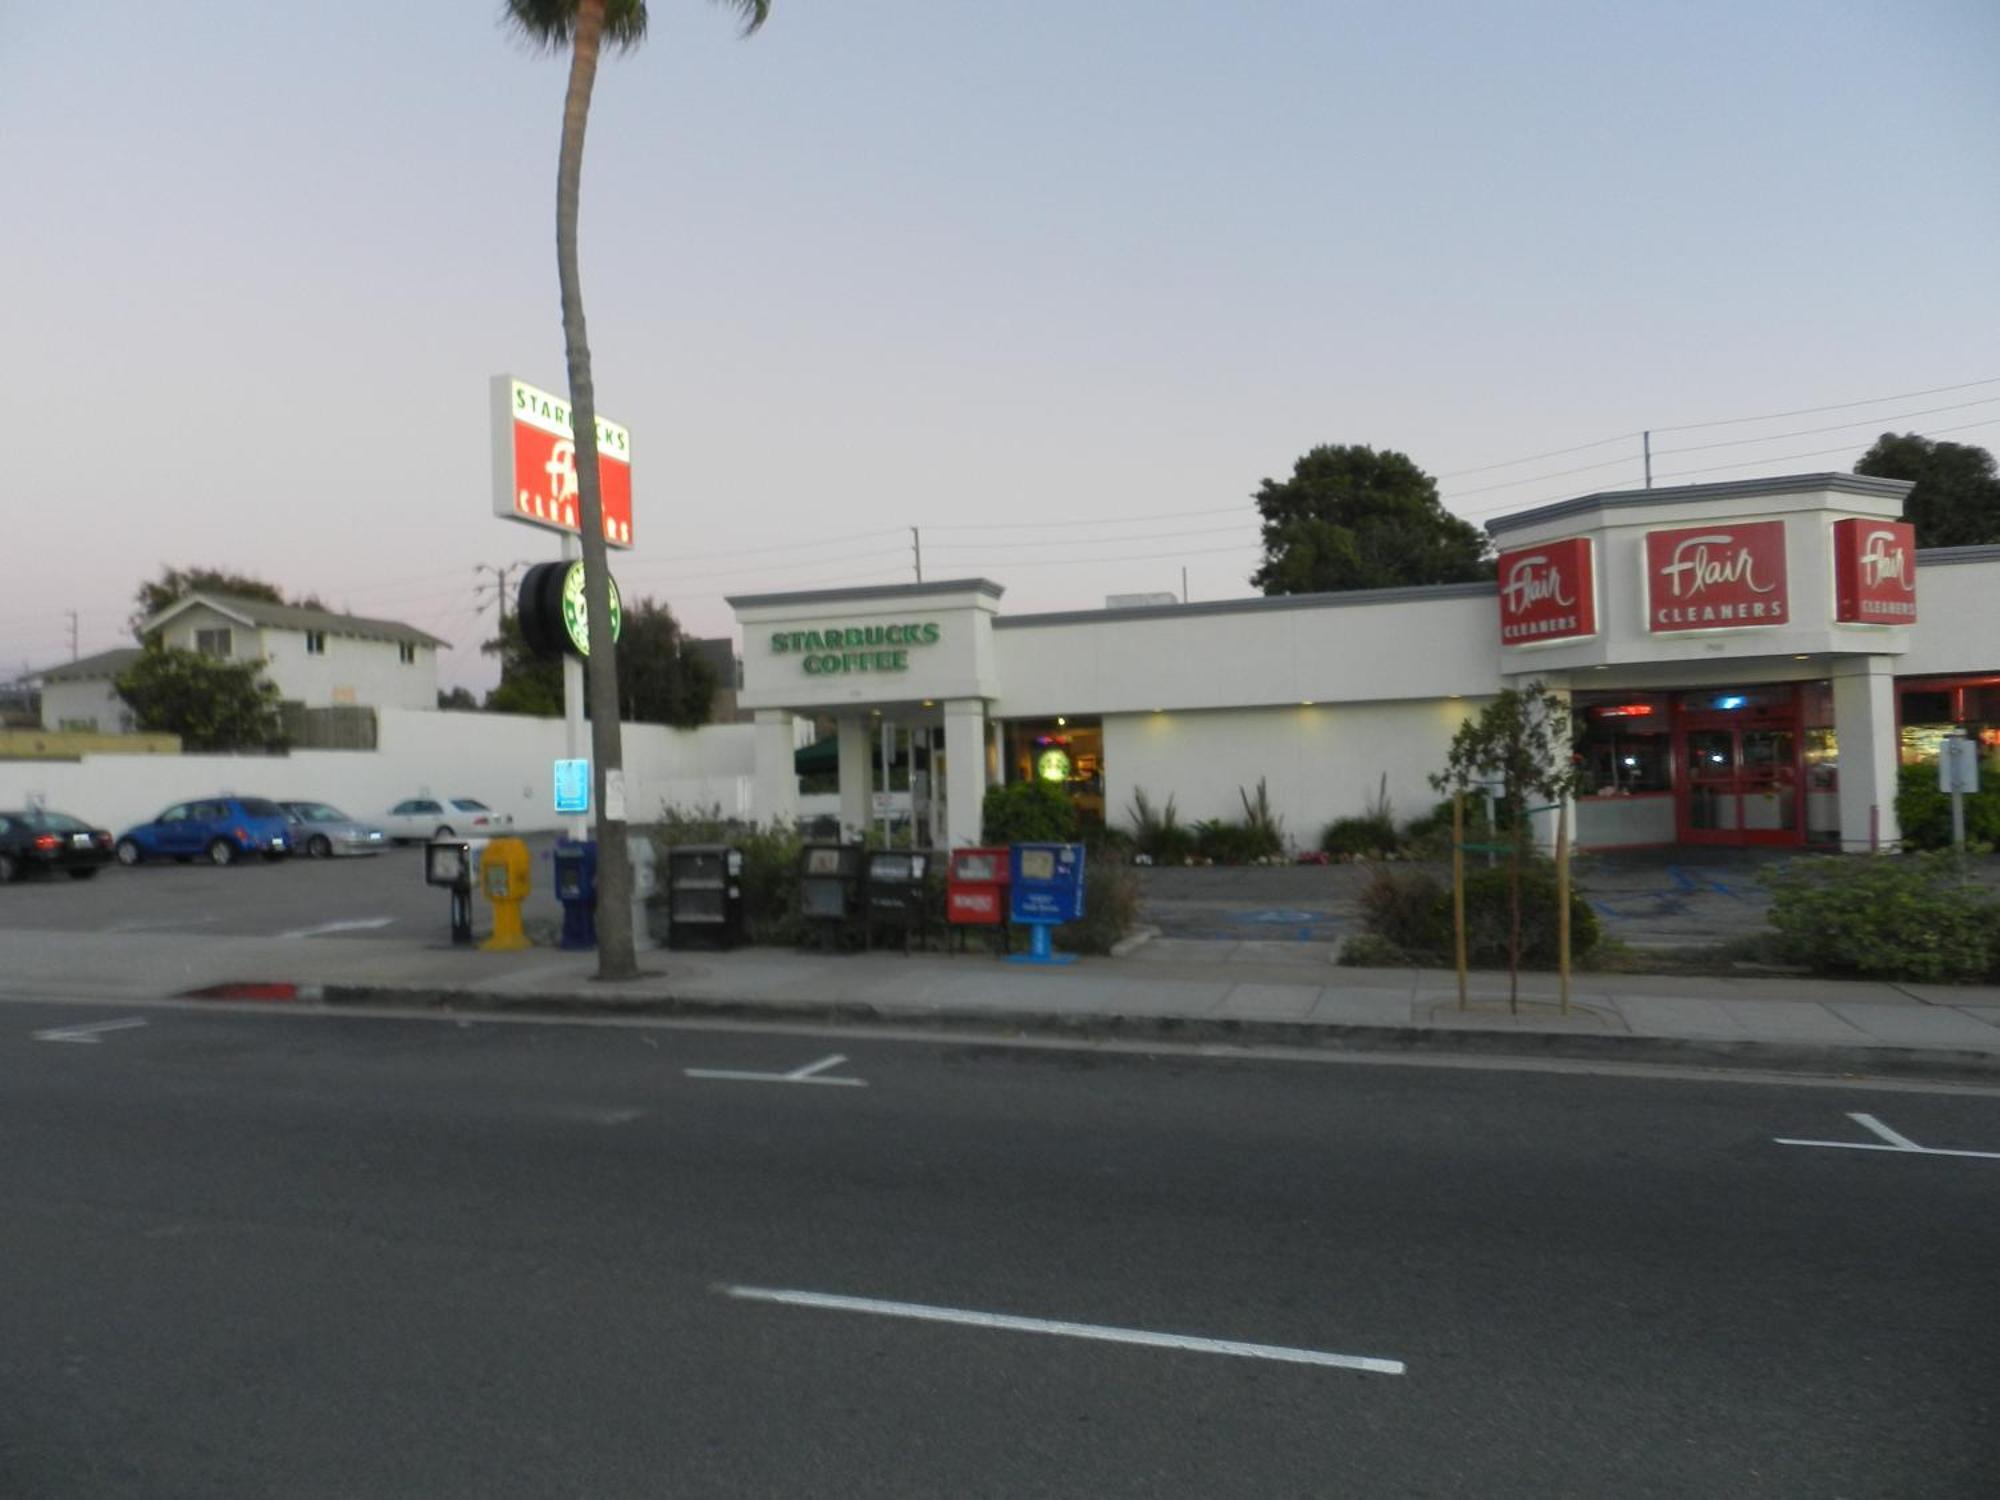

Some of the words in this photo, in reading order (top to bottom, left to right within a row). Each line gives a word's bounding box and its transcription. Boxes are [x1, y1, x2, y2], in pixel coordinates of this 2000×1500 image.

[1661, 535, 1776, 599] Flair
[1503, 556, 1575, 614] Flair
[1658, 601, 1781, 623] CLEANERS
[771, 623, 939, 653] STARBUCKS
[1504, 616, 1576, 637] CLEANERS
[803, 650, 909, 674] COFFEE
